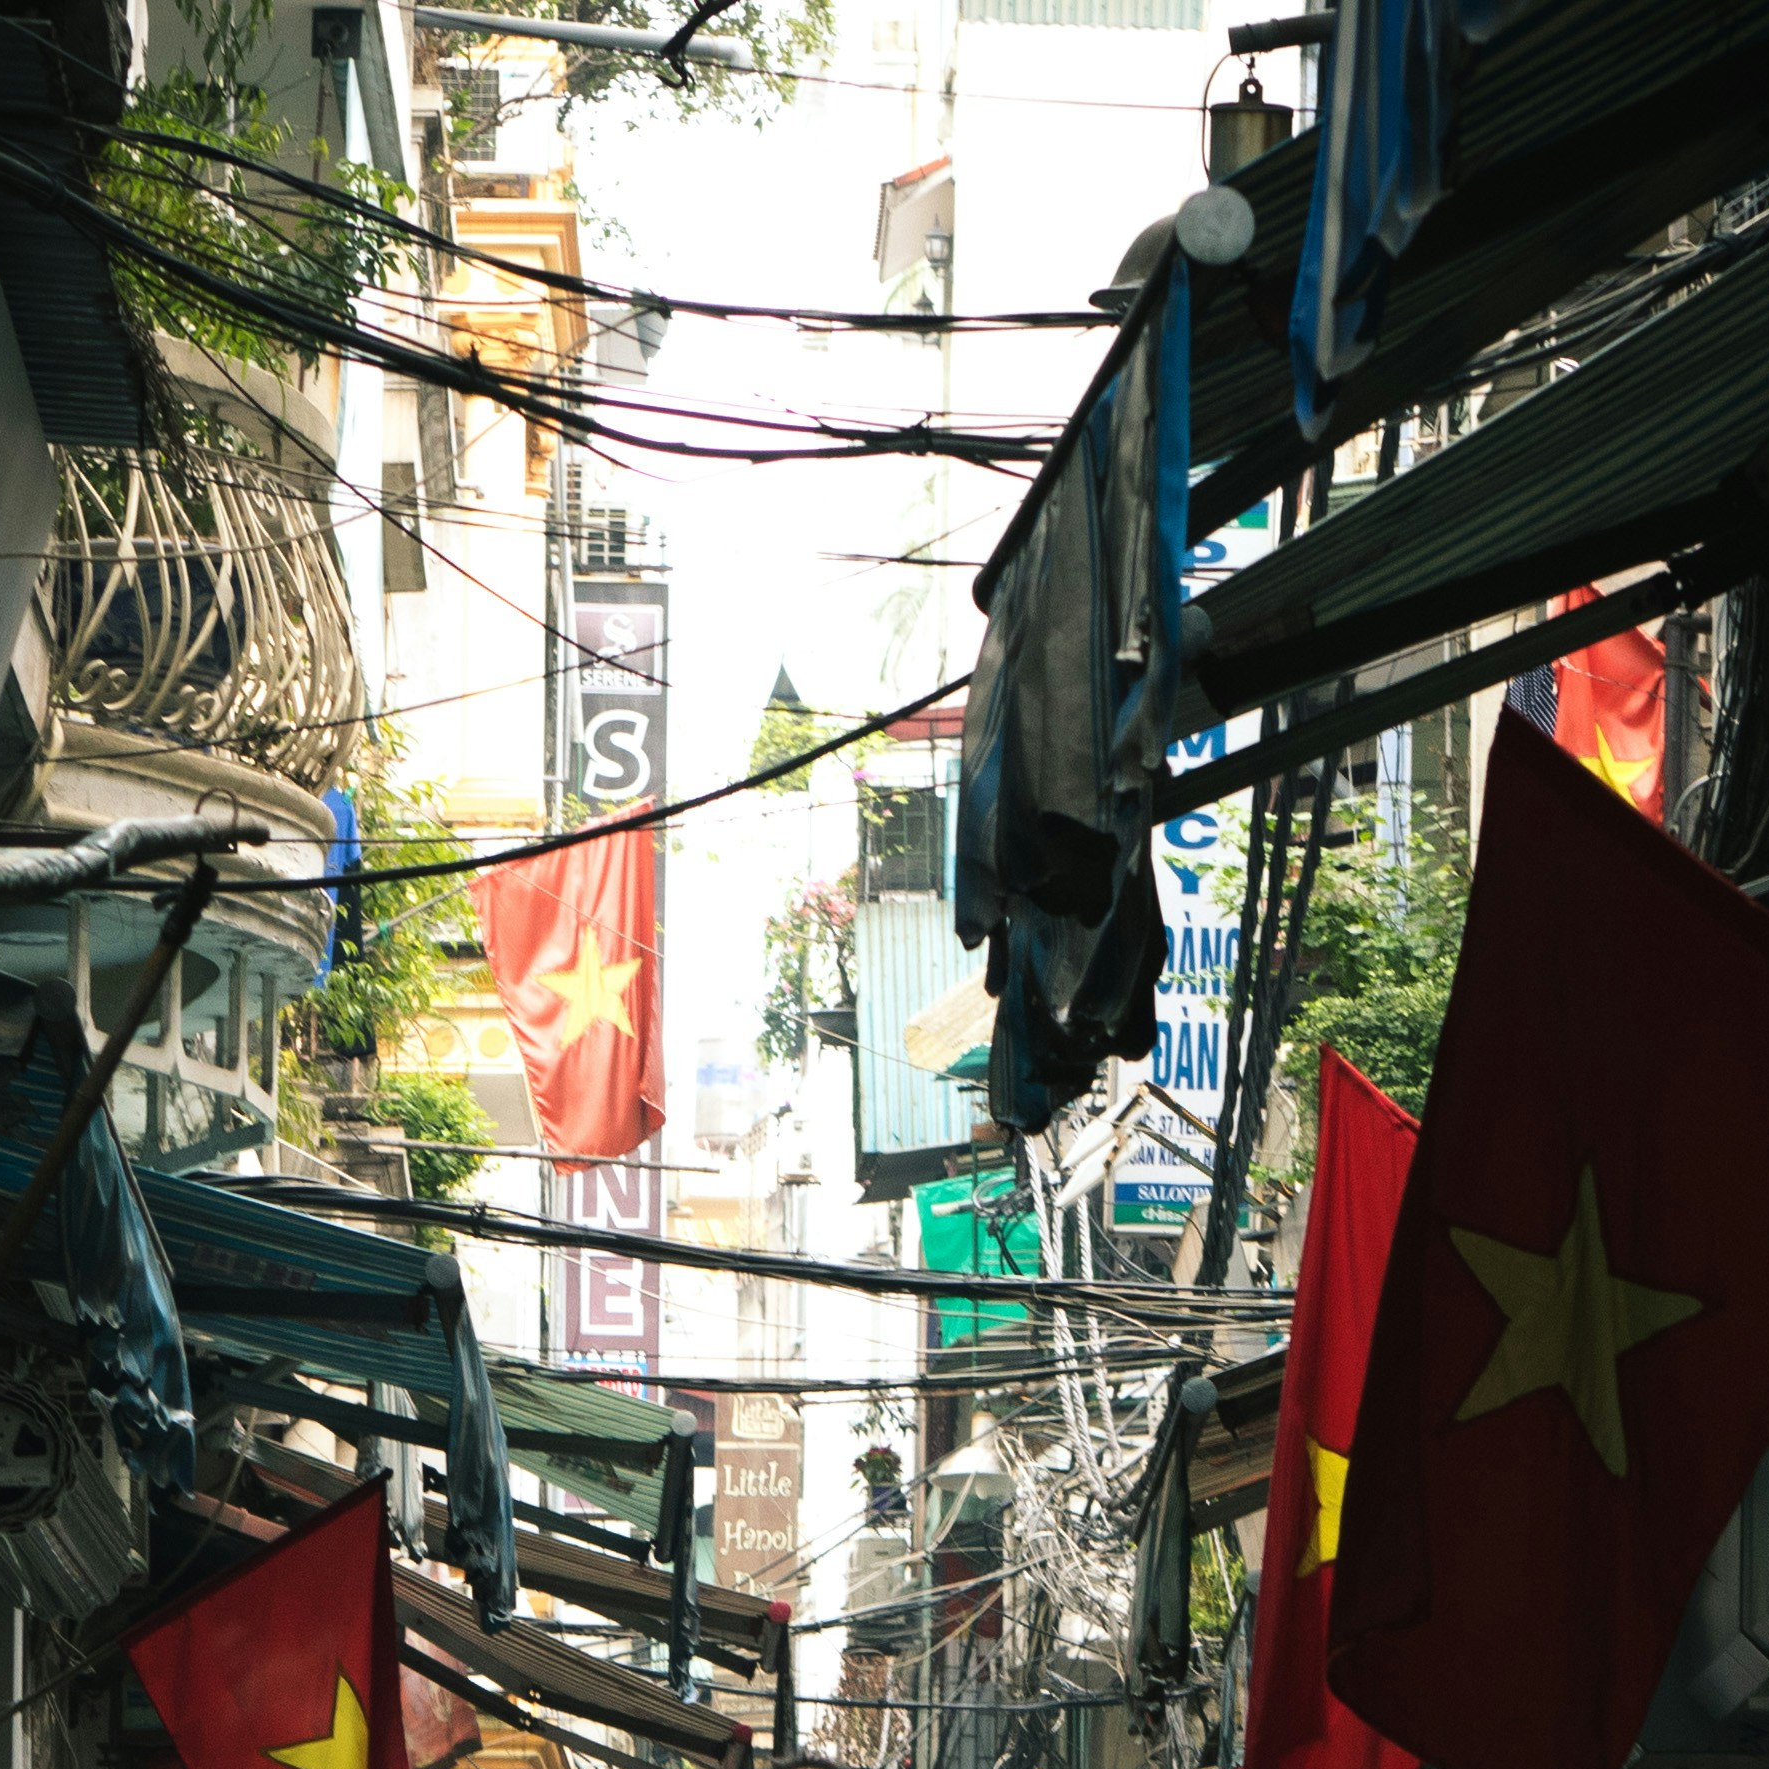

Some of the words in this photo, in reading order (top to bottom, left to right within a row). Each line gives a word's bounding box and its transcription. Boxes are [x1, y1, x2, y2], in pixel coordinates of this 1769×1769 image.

[1152, 1006, 1219, 1091] ĐÀN
[723, 1460, 792, 1497] Little
[720, 1518, 795, 1556] Hanoi
